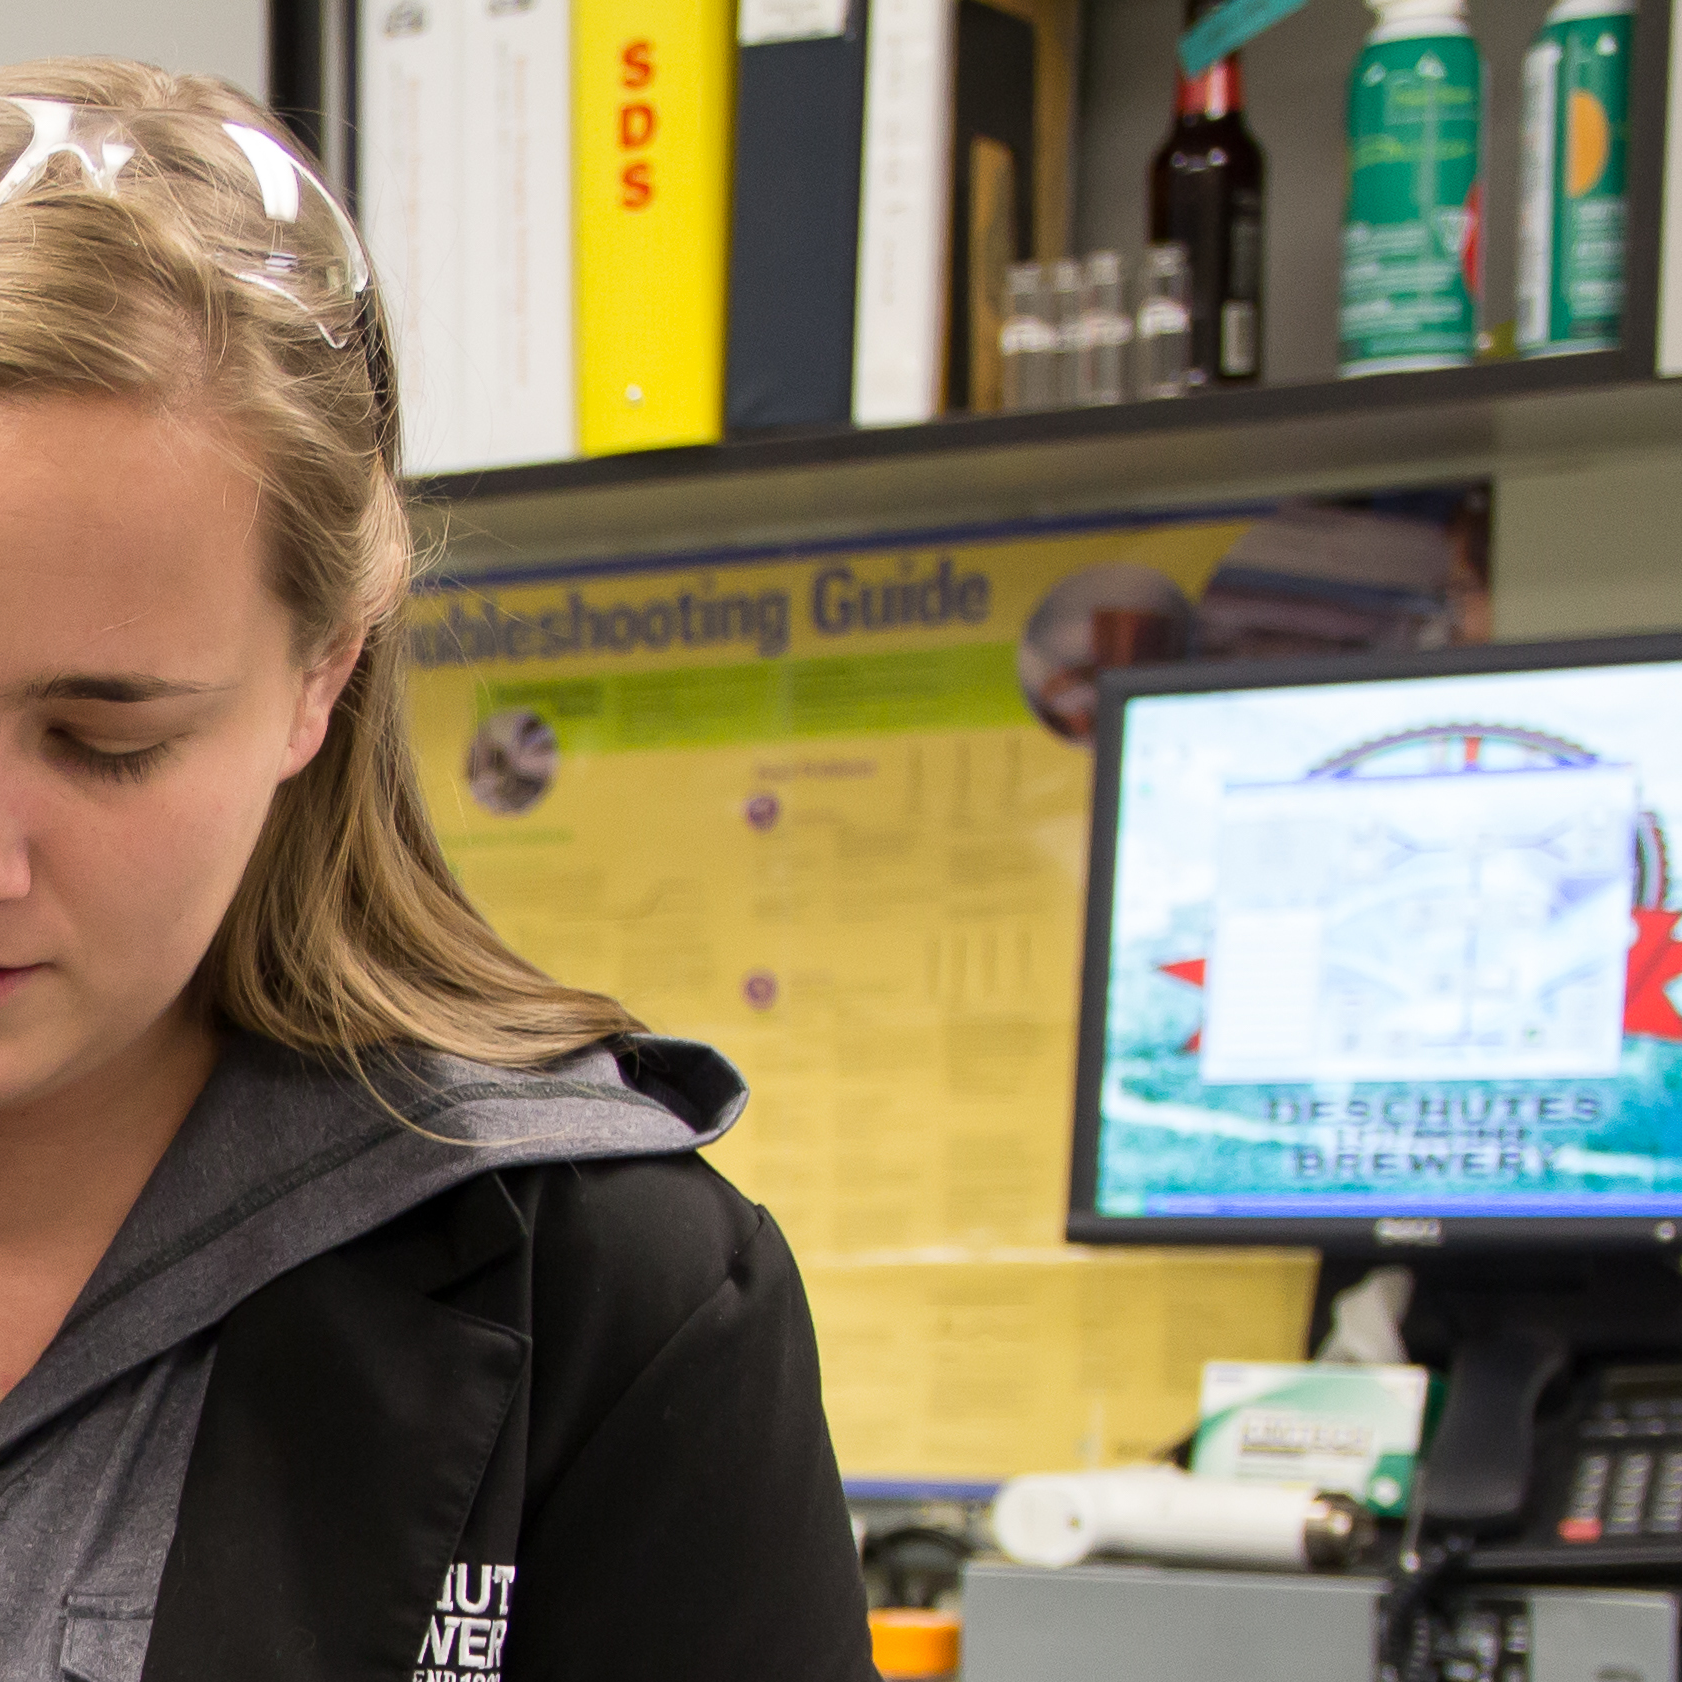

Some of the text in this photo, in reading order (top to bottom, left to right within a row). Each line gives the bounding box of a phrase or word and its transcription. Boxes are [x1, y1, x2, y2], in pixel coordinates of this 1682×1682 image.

[620, 38, 659, 213] SDS
[811, 556, 992, 638] Guide
[1292, 1150, 1555, 1181] BREWERY
